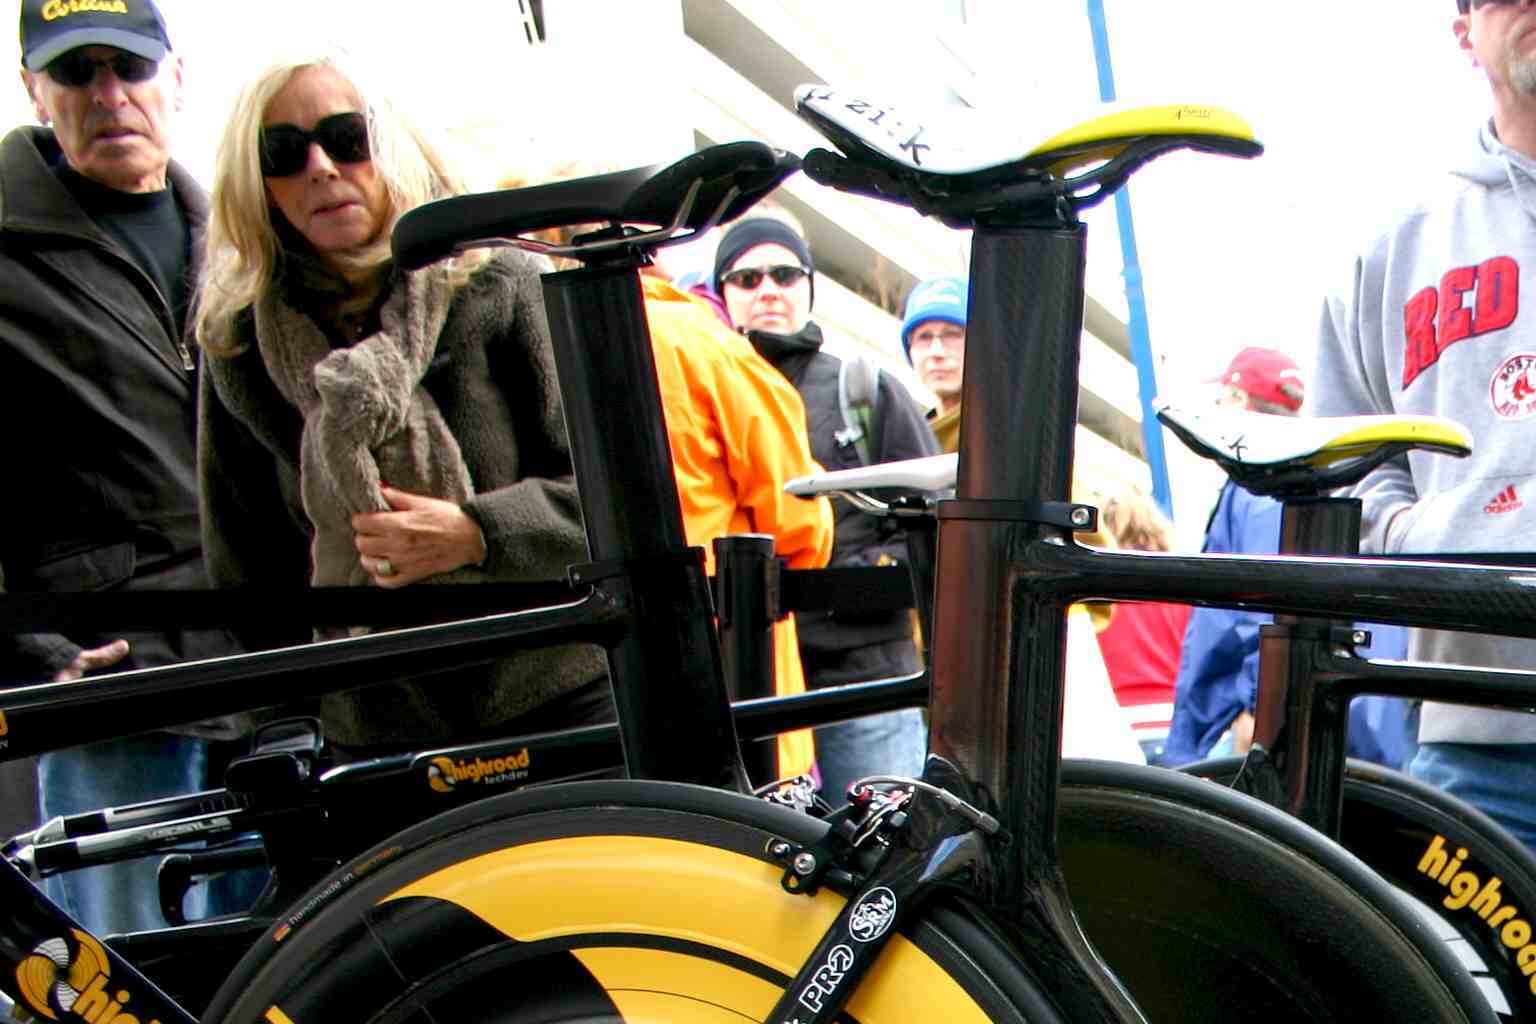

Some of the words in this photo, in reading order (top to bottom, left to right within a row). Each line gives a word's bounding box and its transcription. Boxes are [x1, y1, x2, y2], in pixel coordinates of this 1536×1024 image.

[1401, 256, 1520, 391] RED
[453, 746, 530, 783] highroad
[851, 894, 894, 939] SRM
